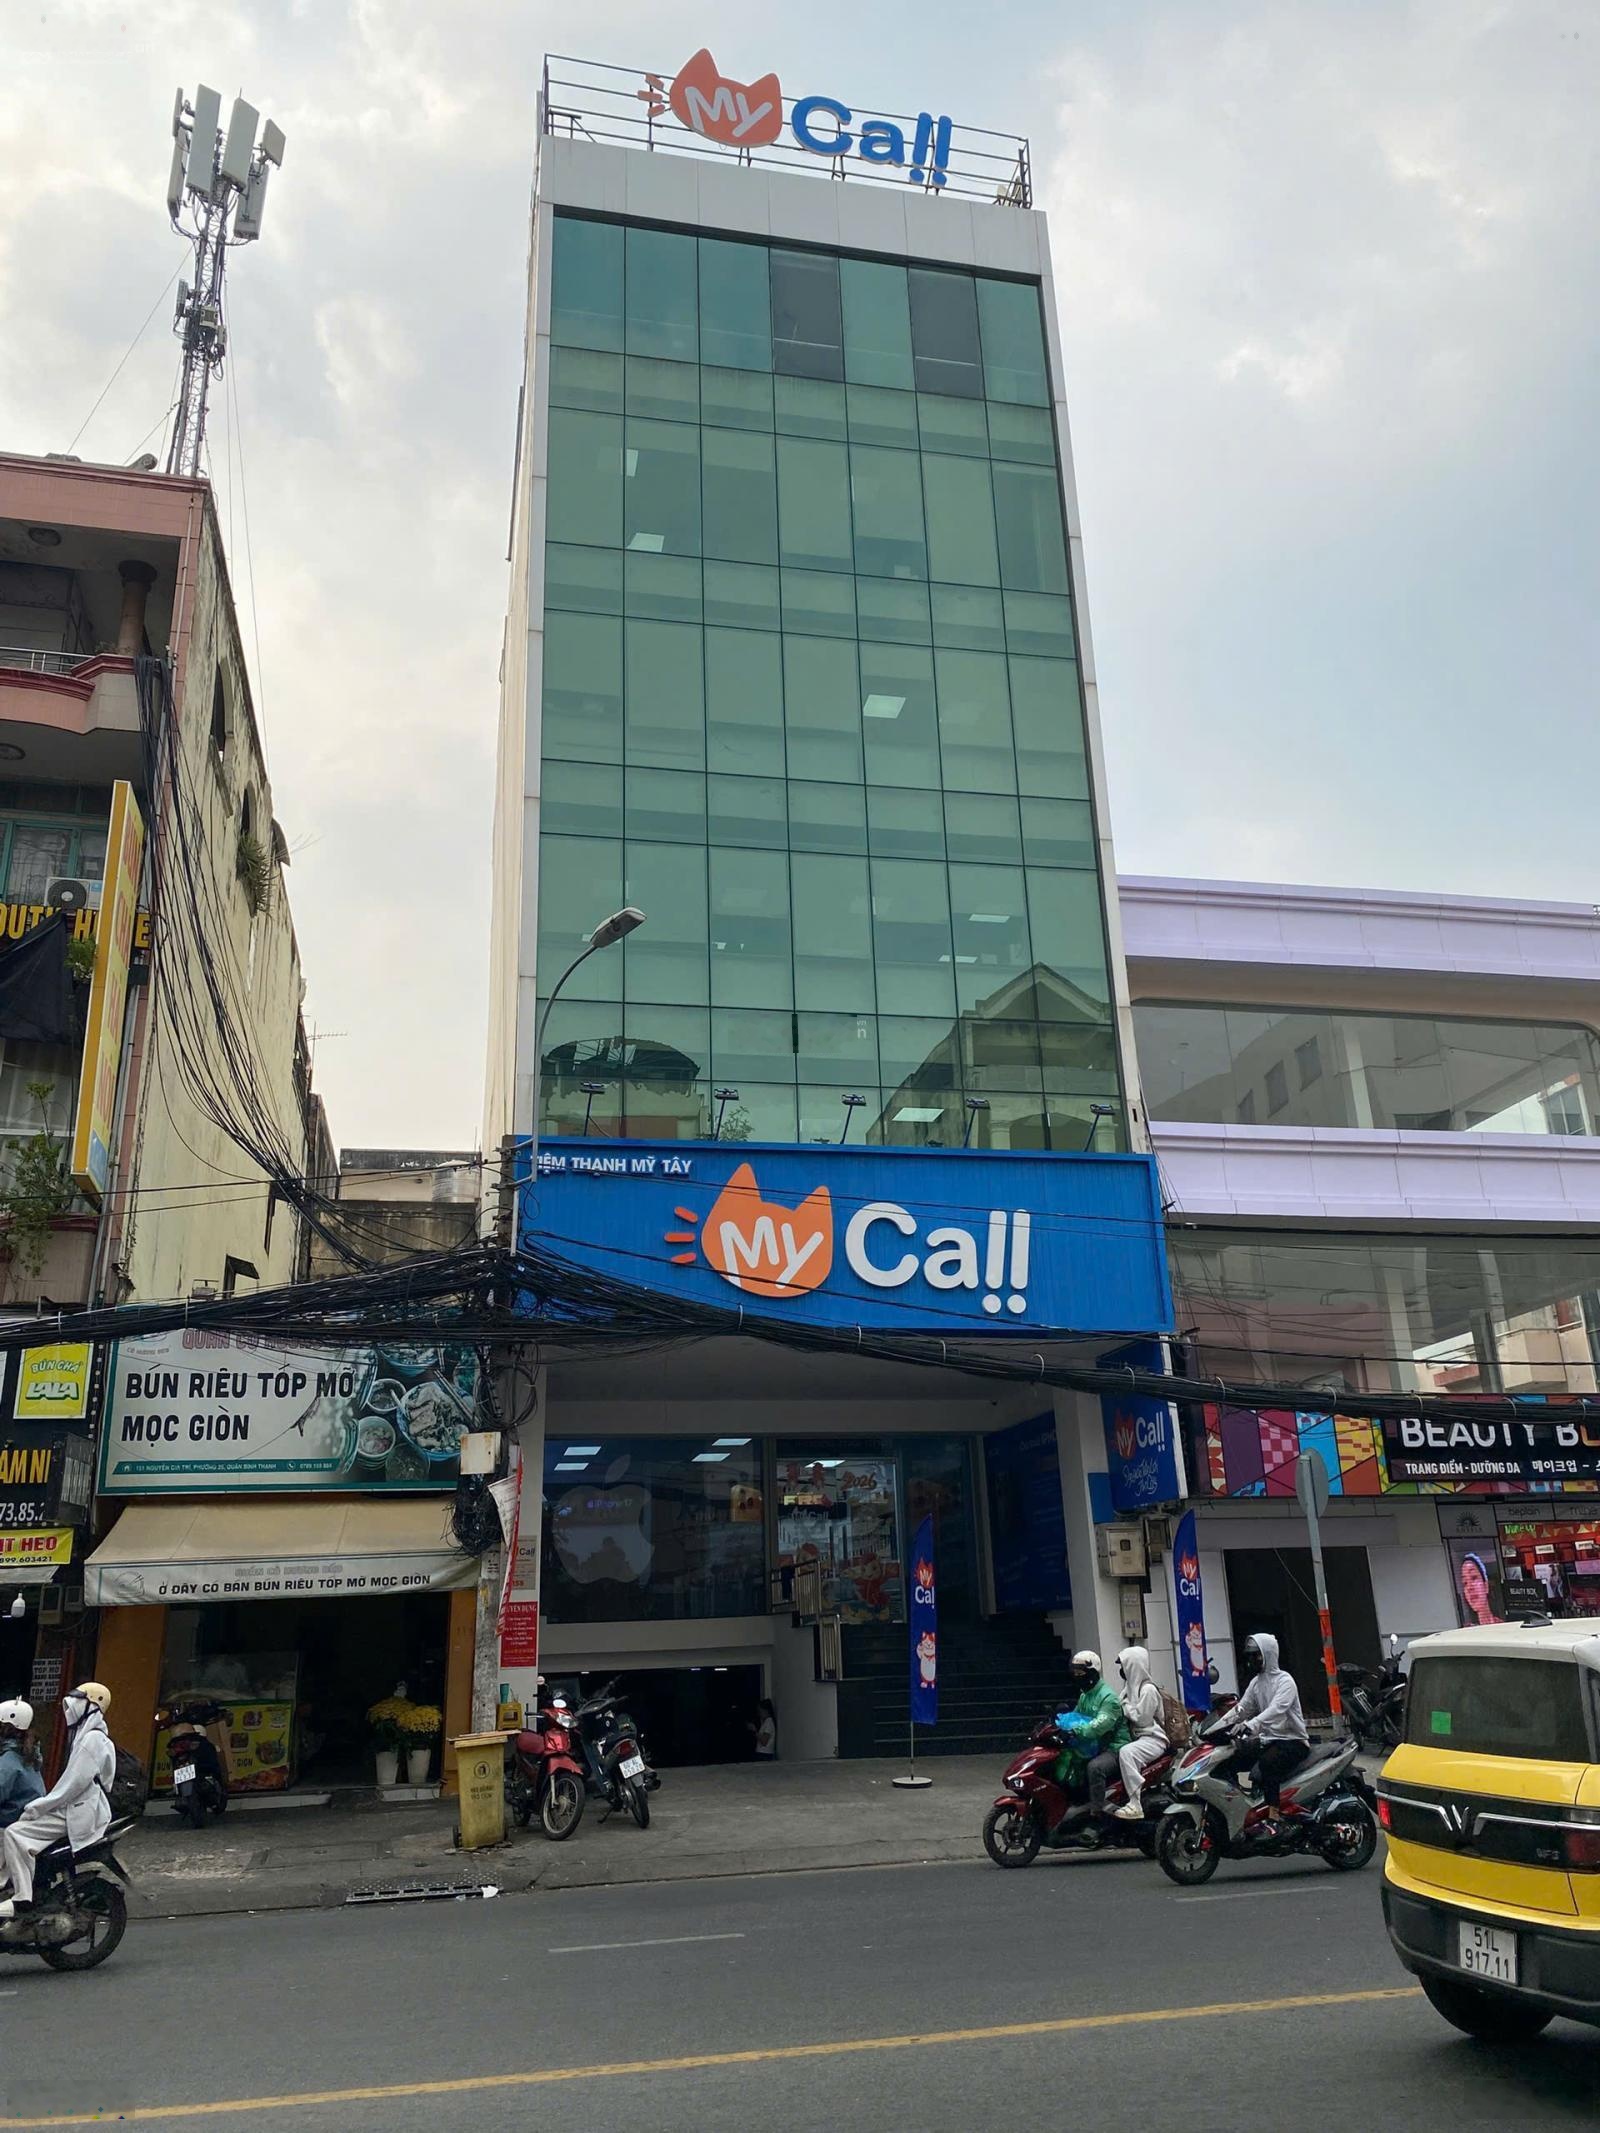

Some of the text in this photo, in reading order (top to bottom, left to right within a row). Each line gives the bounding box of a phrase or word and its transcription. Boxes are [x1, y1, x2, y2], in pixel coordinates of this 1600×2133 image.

[684, 87, 773, 138] My
[571, 1156, 626, 1177] THẠNH
[631, 1155, 657, 1173] MỸ
[662, 1156, 692, 1174] TÂY
[718, 1216, 824, 1289] My
[26, 1381, 80, 1400] LALA
[125, 1363, 357, 1399] BÚN RIÊU TÓP MỠ
[121, 1405, 250, 1448] MỌC GIÒN
[1405, 1463, 1438, 1475] TRANG
[1506, 1462, 1521, 1474] DA
[20, 1535, 58, 1553] HEO
[284, 1578, 314, 1590] RIÊU
[1474, 1926, 1500, 1953] 51L
[1465, 1948, 1510, 1980] 917.11
